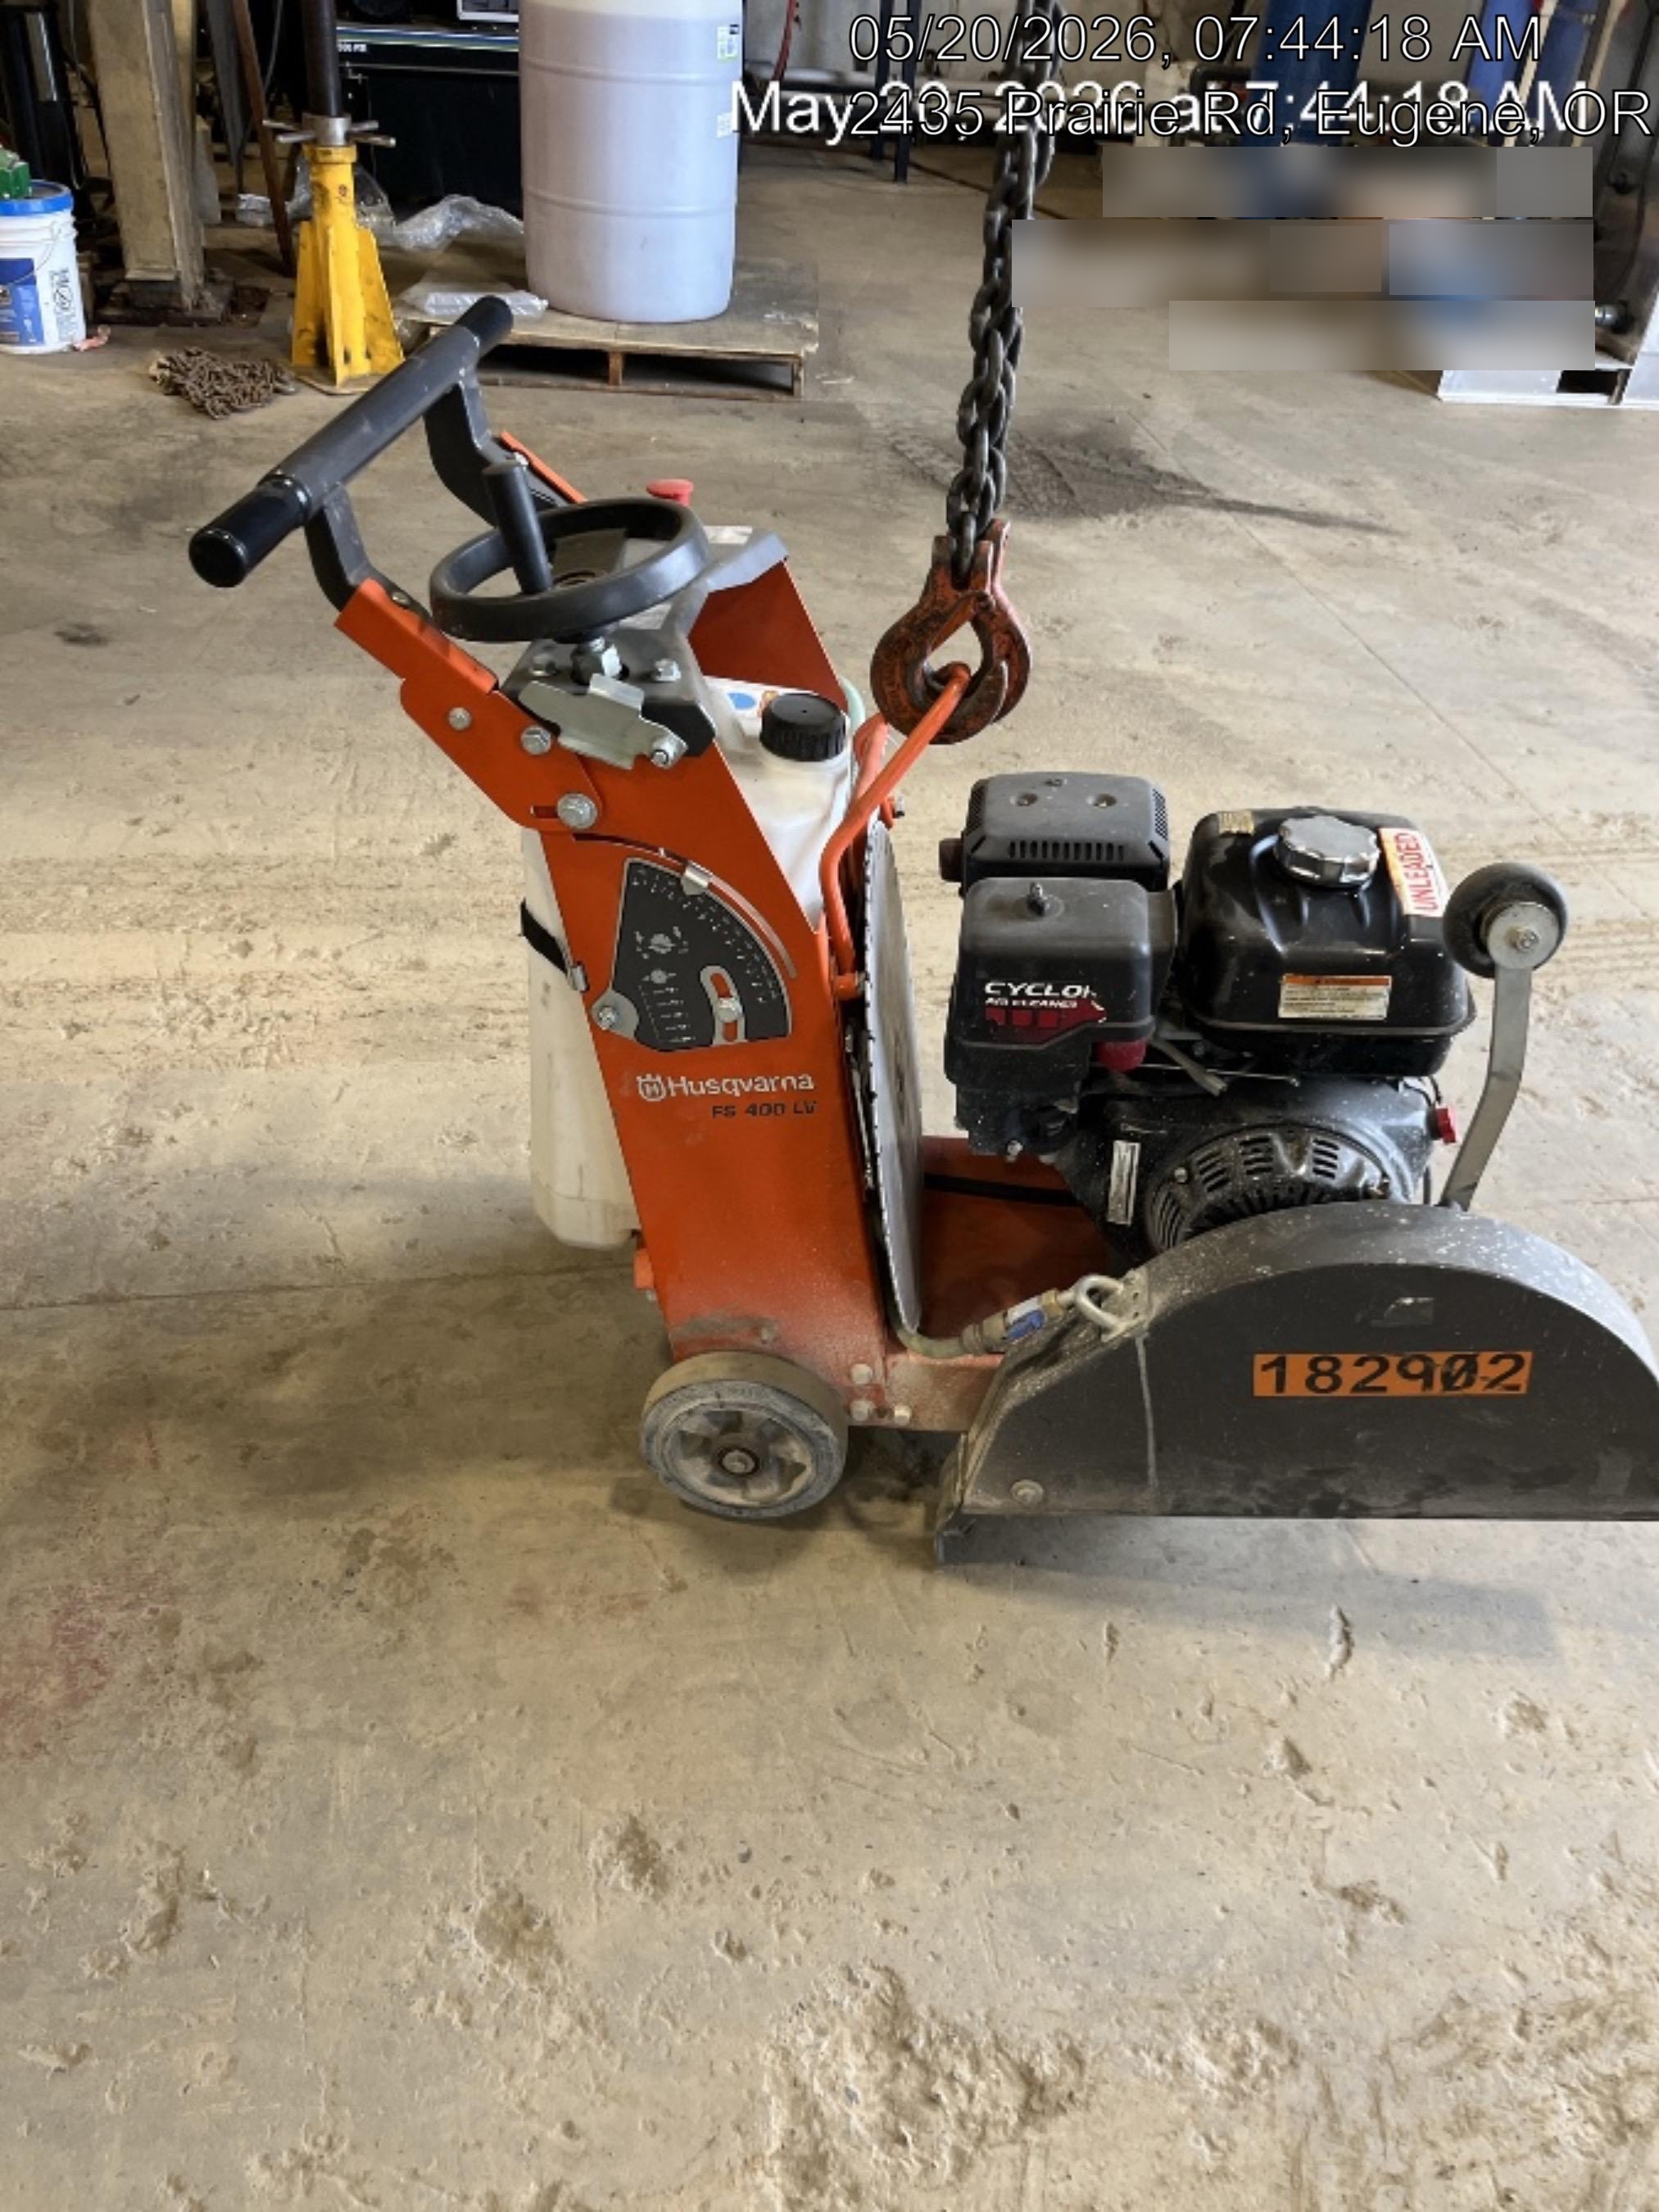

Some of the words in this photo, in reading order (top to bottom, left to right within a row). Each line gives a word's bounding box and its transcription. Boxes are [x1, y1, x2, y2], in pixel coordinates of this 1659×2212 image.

[1394, 832, 1439, 911] UNLEADED
[668, 1073, 815, 1097] Husqvarna
[711, 1105, 737, 1120] FS
[745, 1103, 786, 1117] 400
[1260, 1352, 1525, 1394] 182902
